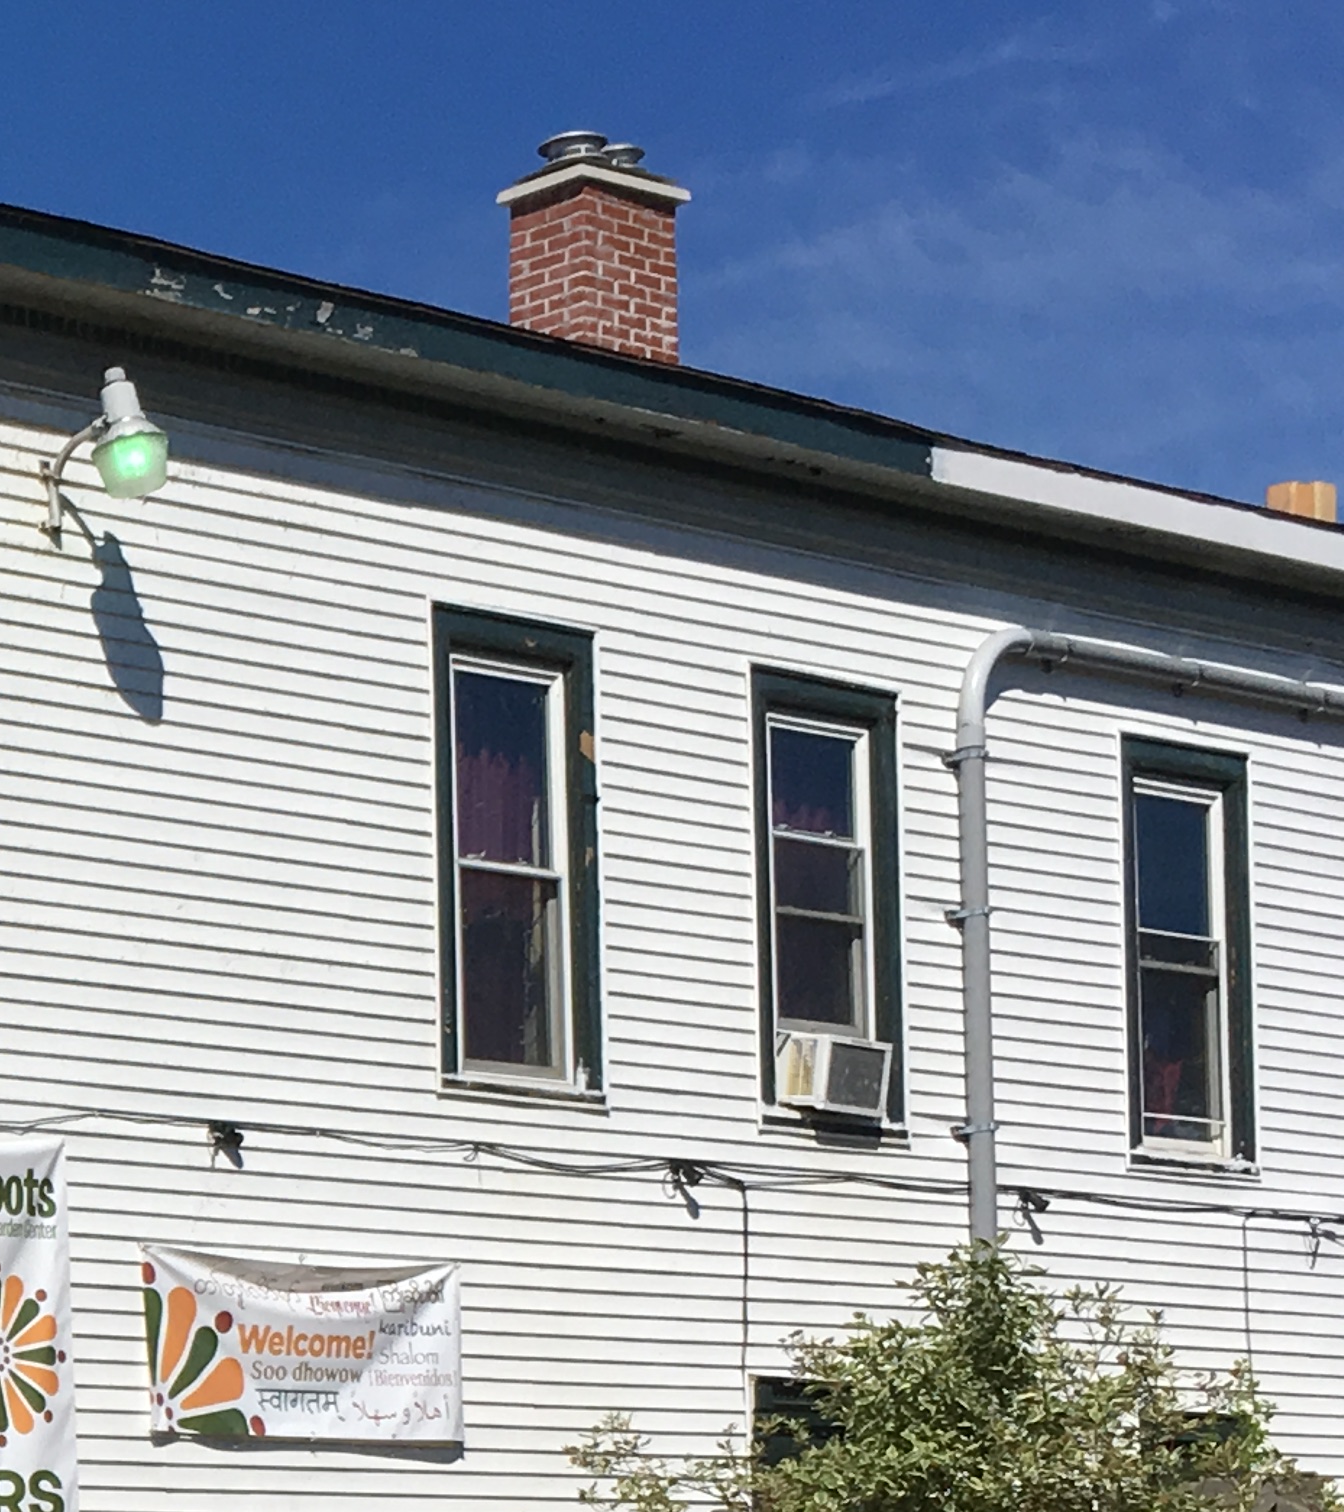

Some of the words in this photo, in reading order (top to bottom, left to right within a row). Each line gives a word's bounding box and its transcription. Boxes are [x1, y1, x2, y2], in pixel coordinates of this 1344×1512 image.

[377, 1319, 453, 1337] karibuni
[237, 1323, 376, 1361] Welcome!
[377, 1341, 440, 1366] Shalom
[250, 1360, 288, 1381] Soo
[292, 1361, 363, 1384] dhowow
